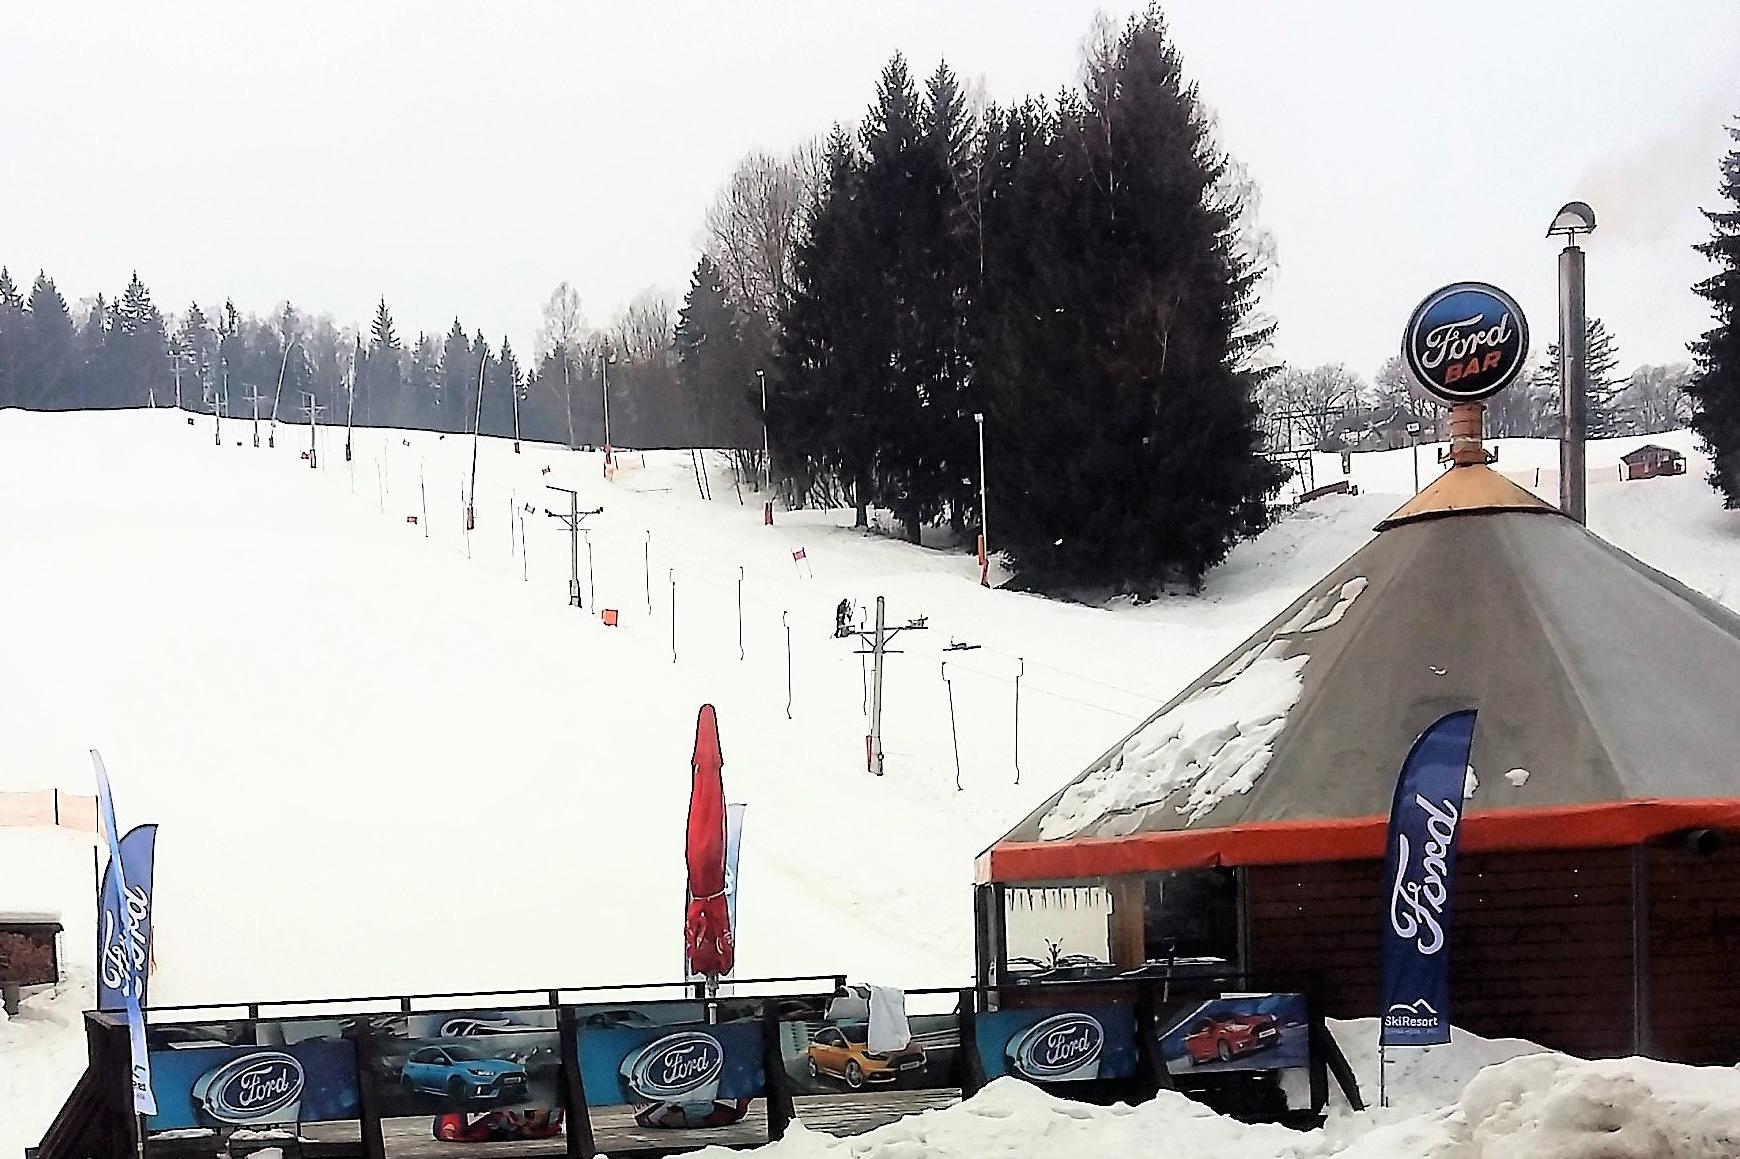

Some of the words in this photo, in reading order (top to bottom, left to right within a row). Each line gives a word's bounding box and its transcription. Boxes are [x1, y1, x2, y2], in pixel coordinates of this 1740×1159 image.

[1421, 313, 1512, 369] Ford
[1444, 350, 1502, 385] BAR
[1391, 794, 1457, 955] Ford
[1384, 1015, 1438, 1027] SkiResort
[663, 1045, 709, 1084] Ford
[1046, 1026, 1090, 1064] Ford
[239, 1065, 289, 1106] Ford
